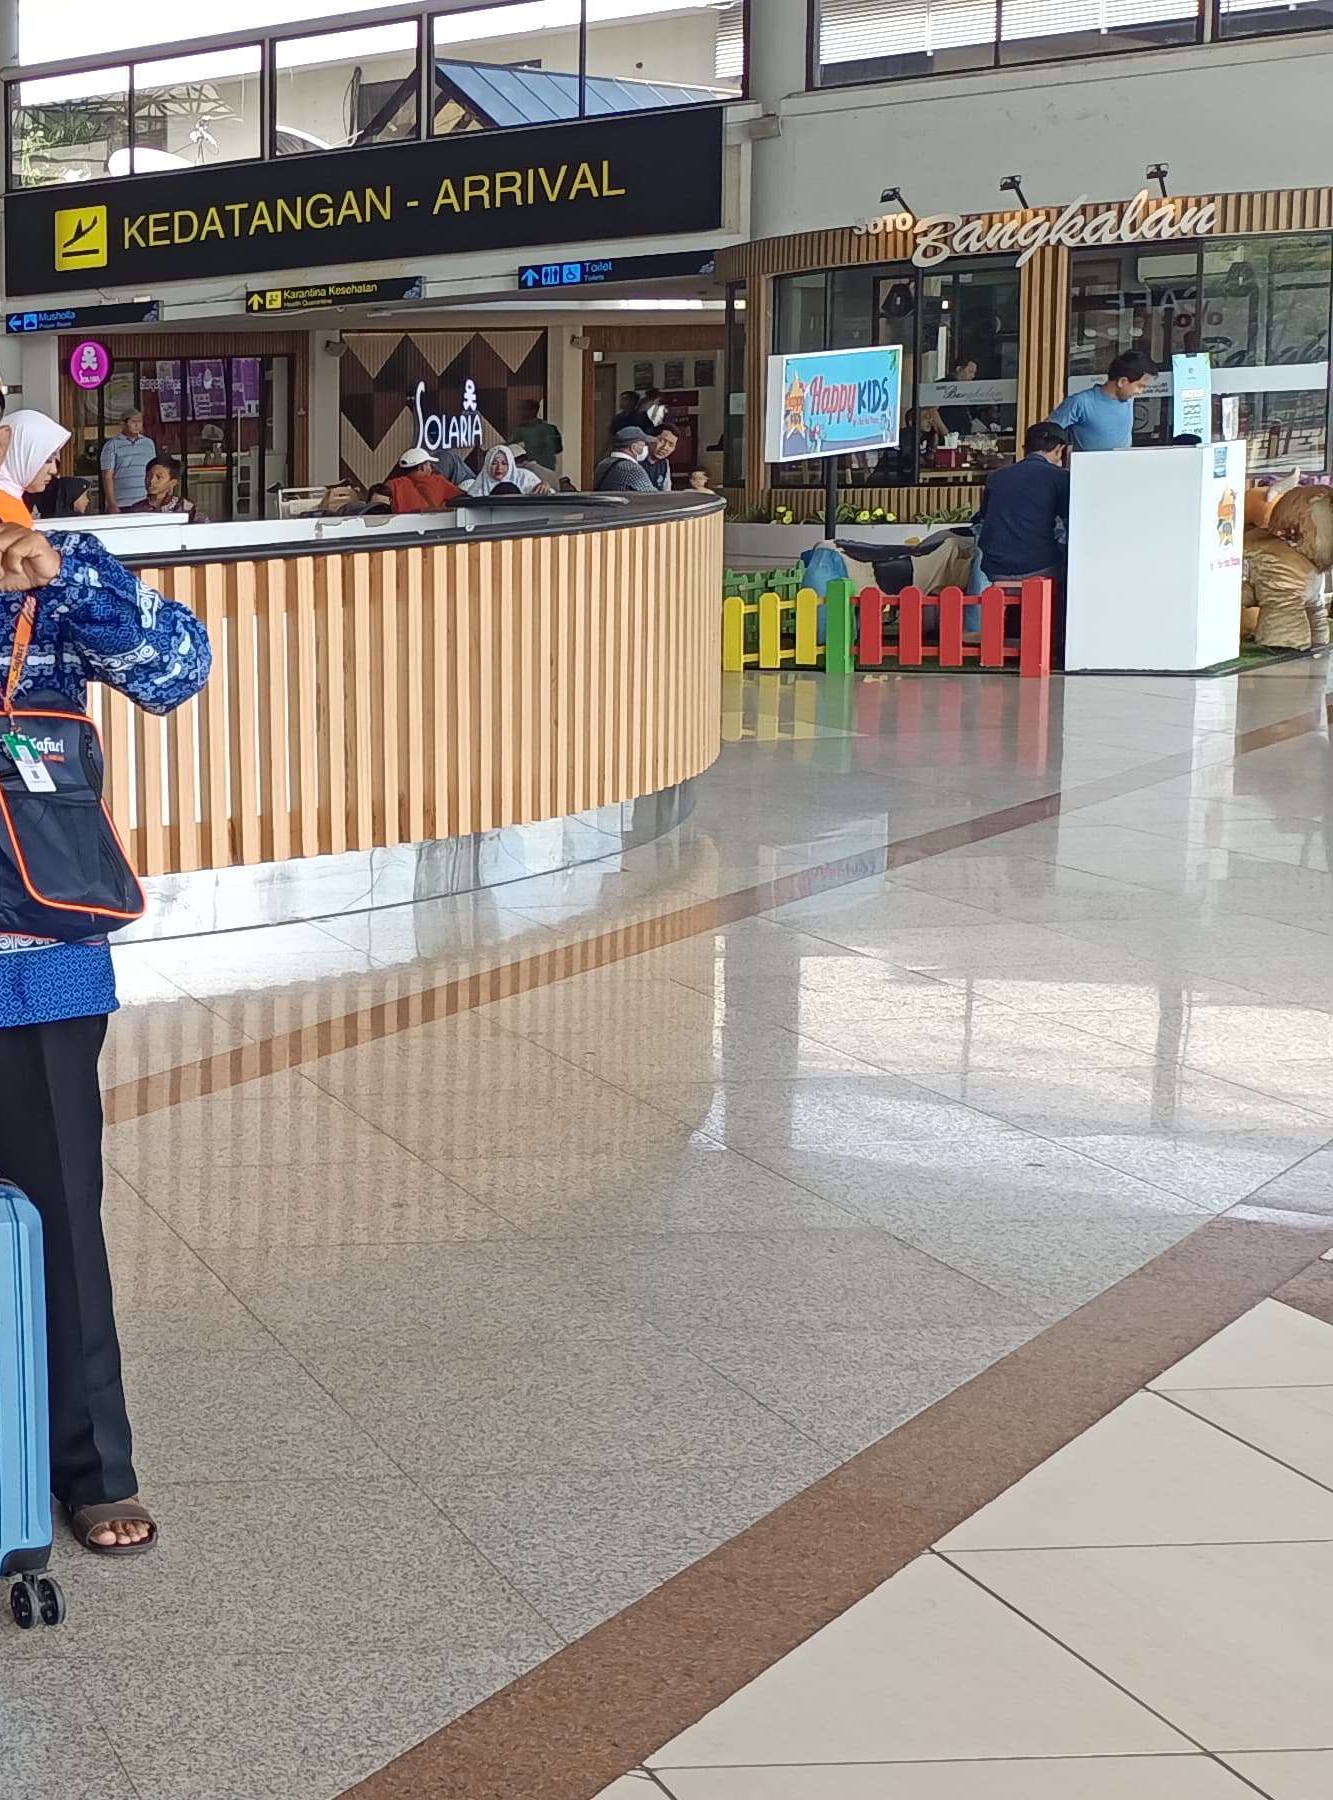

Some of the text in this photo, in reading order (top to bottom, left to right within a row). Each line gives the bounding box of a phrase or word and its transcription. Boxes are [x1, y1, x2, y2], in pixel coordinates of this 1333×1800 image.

[122, 185, 393, 250] KEDATANGAN
[431, 160, 627, 216] ARRIVAL
[853, 188, 1217, 268] SOTO Bangkalan
[284, 283, 378, 300] Karantina Kesehatan
[583, 260, 613, 273] Toilet
[416, 381, 482, 450] SOLARIA
[810, 375, 889, 425] Happy KIDS
